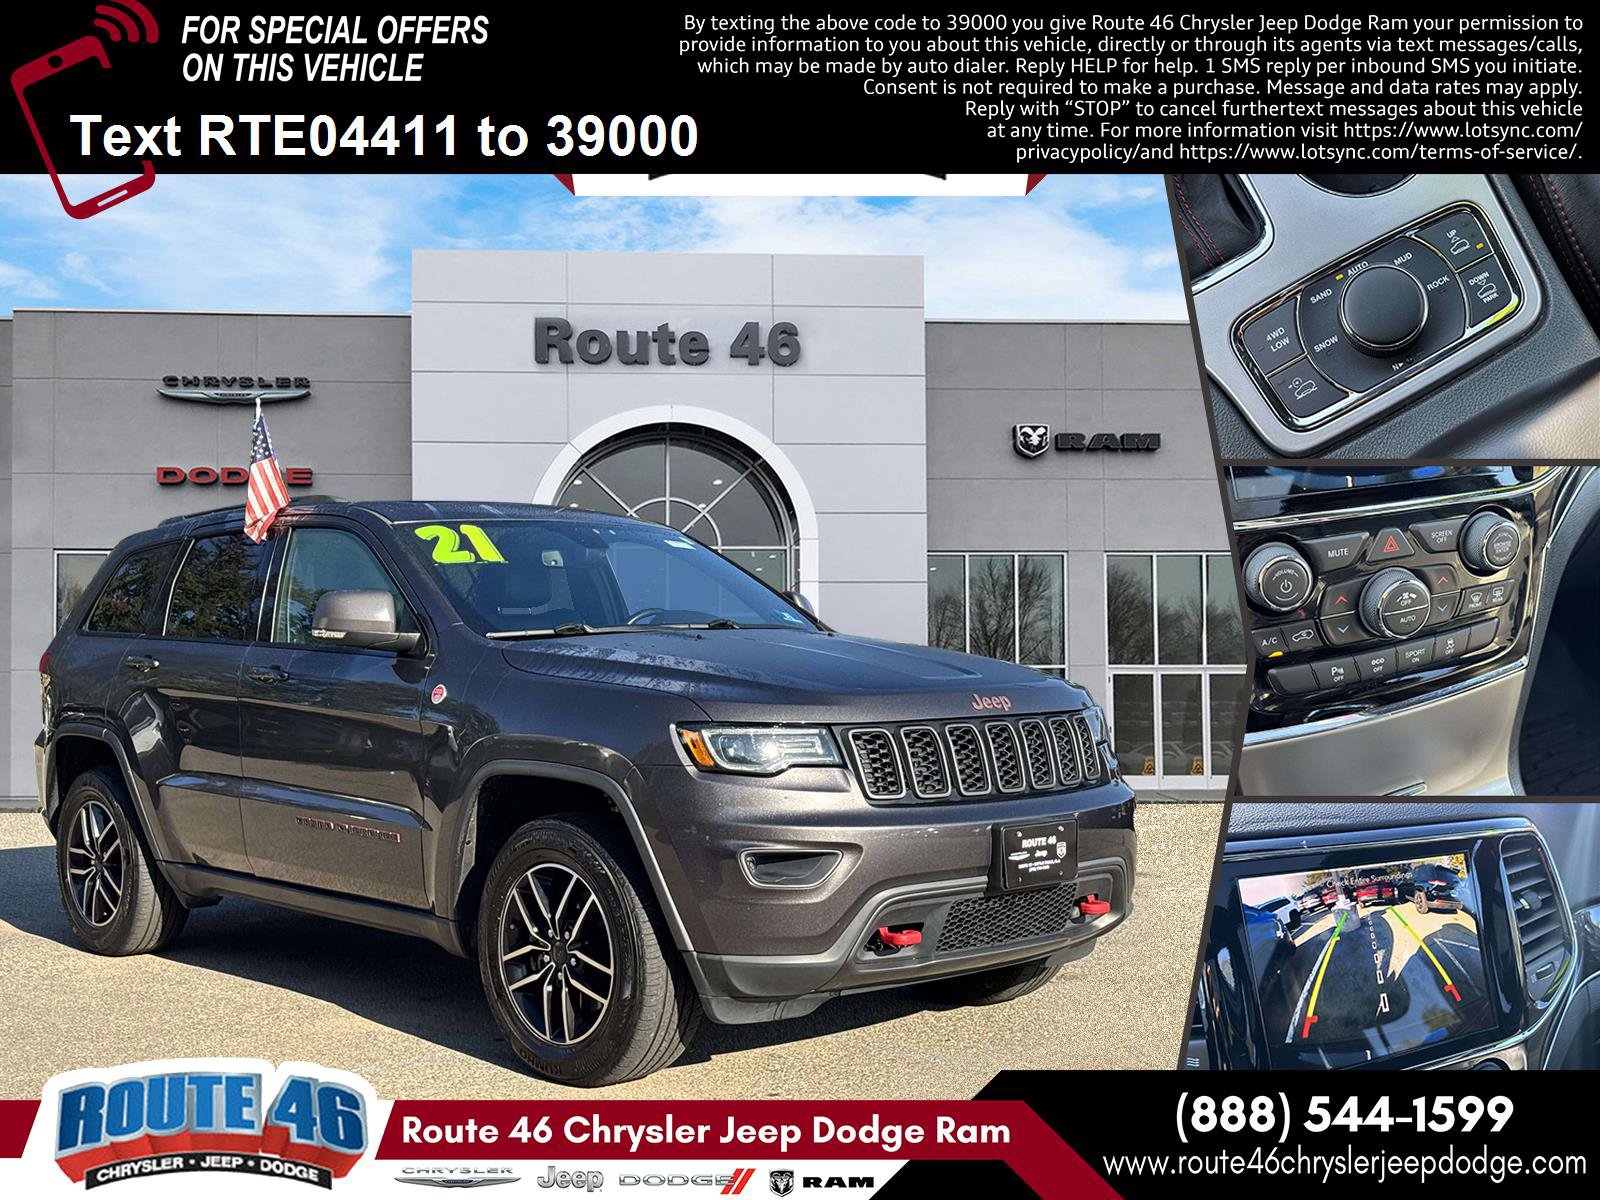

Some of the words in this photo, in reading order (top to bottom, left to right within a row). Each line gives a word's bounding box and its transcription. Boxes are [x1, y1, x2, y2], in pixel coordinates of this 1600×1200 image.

[1446, 229, 1457, 239] UP
[1393, 252, 1413, 266] MUD
[1348, 261, 1369, 276] AUTO
[1426, 275, 1450, 291] ROCK
[1468, 271, 1490, 286] DOWN
[1310, 288, 1333, 304] SAND
[1483, 292, 1499, 304] PARK
[1266, 327, 1285, 342] 4WD
[534, 317, 710, 366] Route
[729, 321, 801, 367] 46
[1270, 336, 1290, 352] LOW
[1313, 335, 1339, 352] SNOW
[162, 375, 311, 388] CHRYSLER
[1055, 432, 1161, 451] RAM
[156, 466, 313, 485] DODE
[1431, 529, 1454, 539] SCREEN
[415, 524, 506, 564] 21
[1327, 548, 1349, 558] MUTE
[1275, 569, 1296, 577] VOLUME
[1400, 615, 1416, 623] AUTO
[1262, 636, 1278, 646] A/C
[1405, 648, 1426, 658] SPORT
[1371, 657, 1385, 665] eco
[972, 693, 1012, 711] Jeep
[1022, 836, 1047, 848] ROUTE
[1047, 834, 1057, 845] 46
